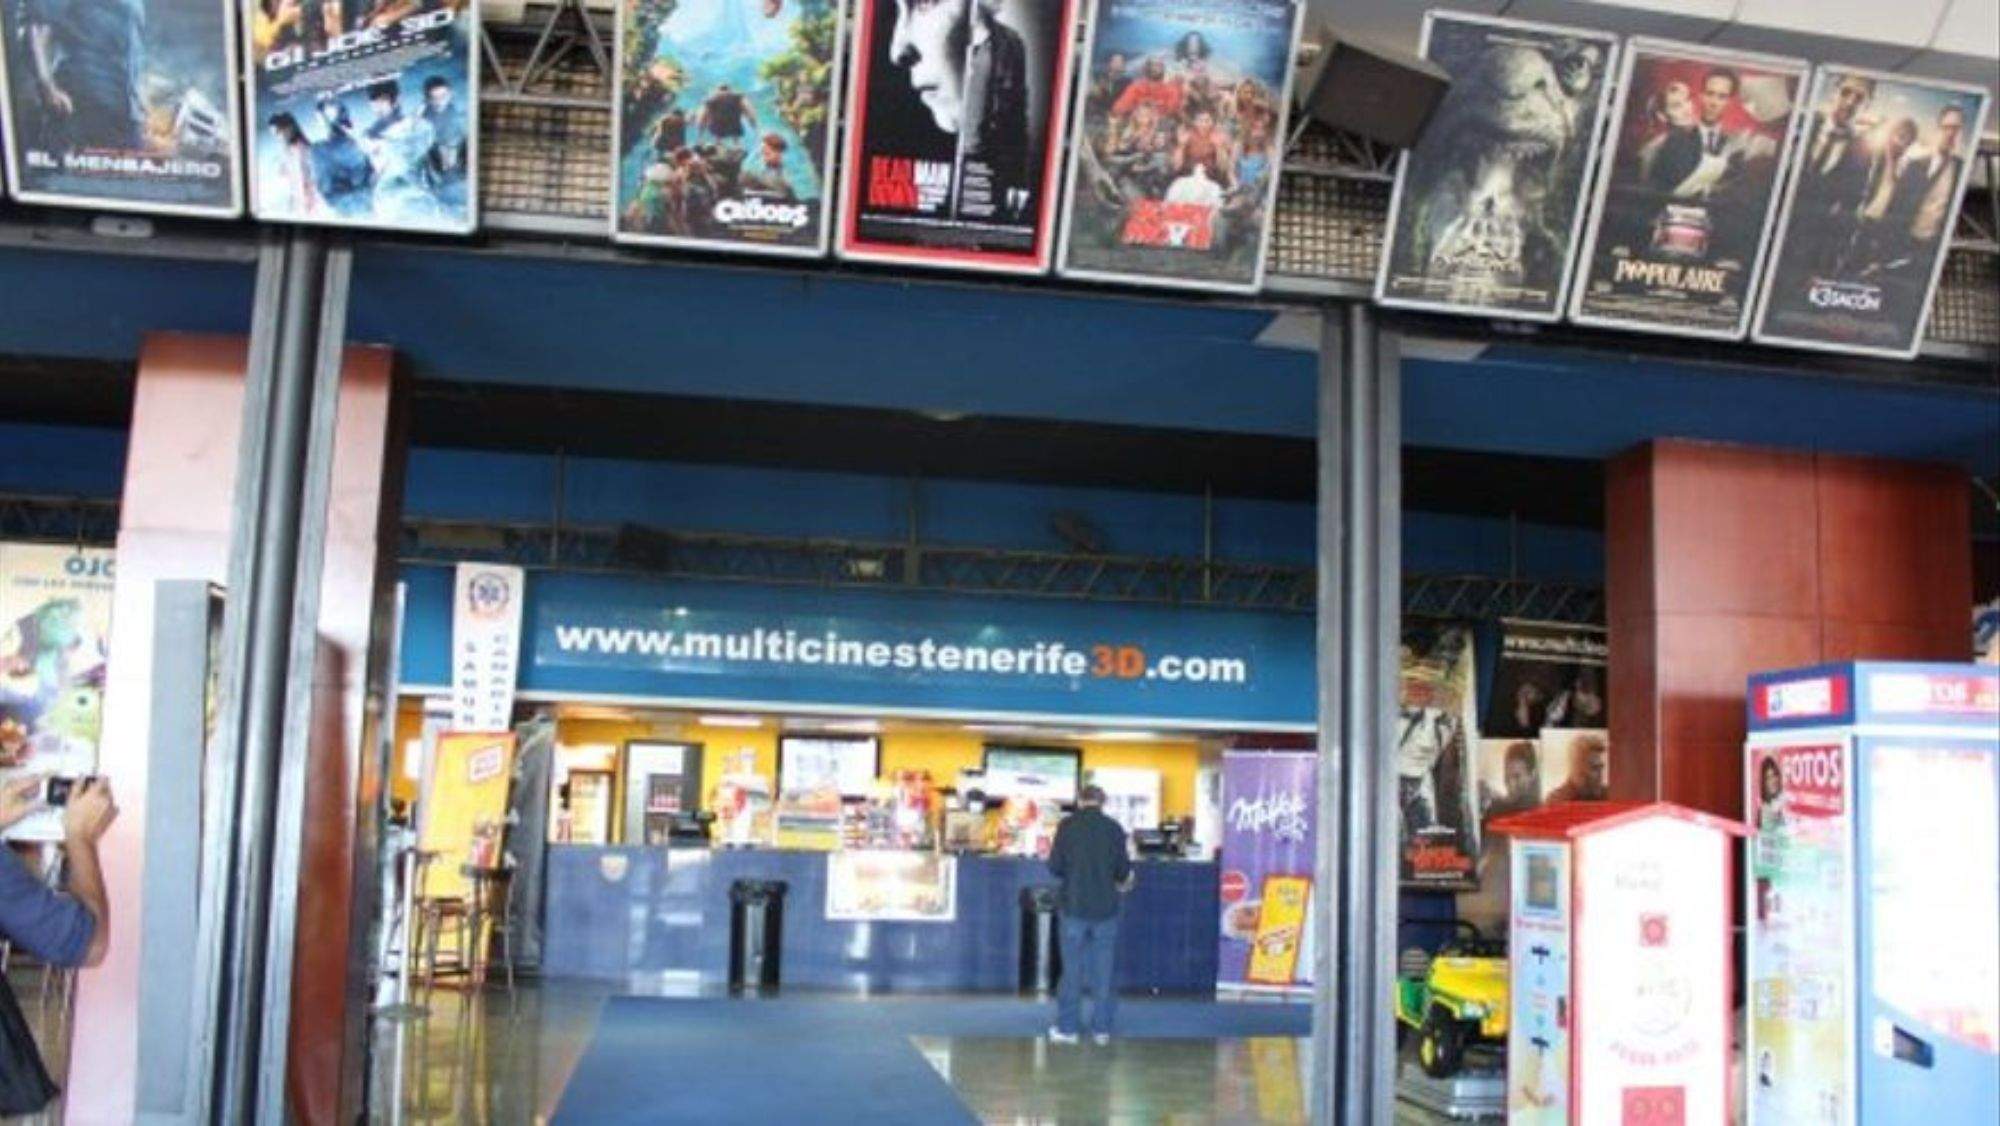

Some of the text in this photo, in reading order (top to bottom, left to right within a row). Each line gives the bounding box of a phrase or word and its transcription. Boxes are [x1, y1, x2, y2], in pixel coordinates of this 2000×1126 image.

[26, 151, 58, 168] EL
[1614, 259, 1727, 292] POPULAIRE
[1782, 751, 1842, 786] FOTOS
